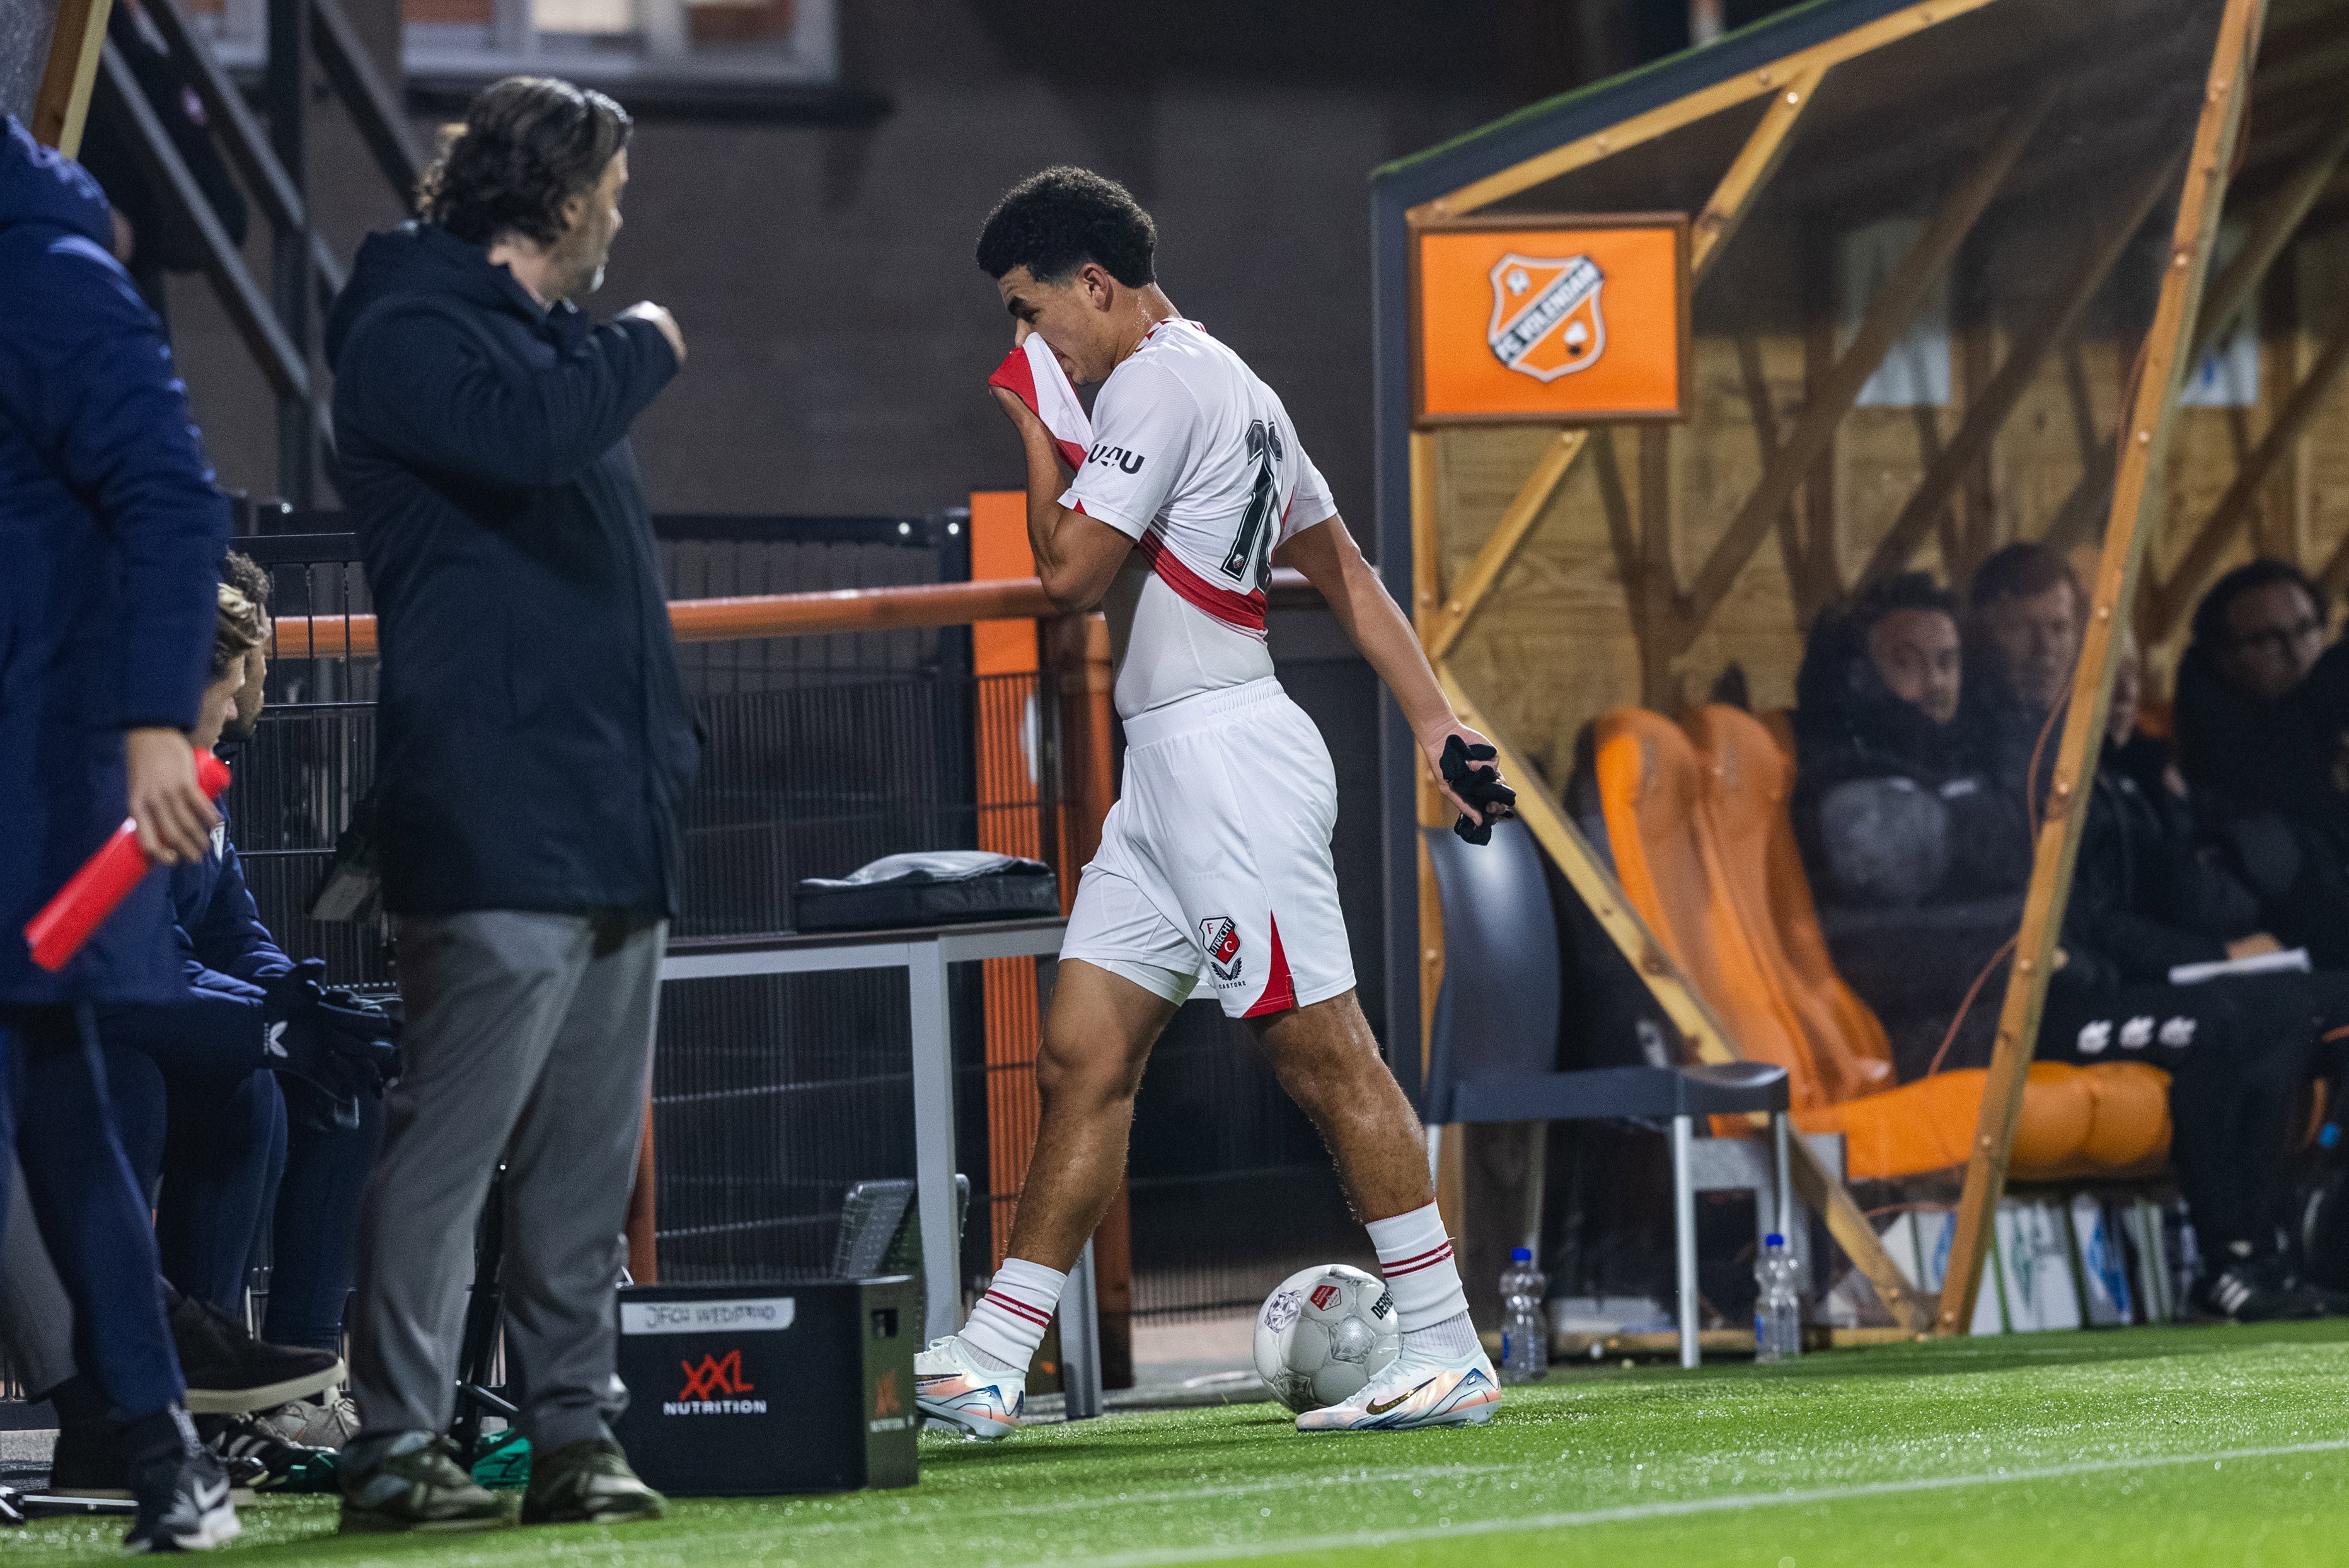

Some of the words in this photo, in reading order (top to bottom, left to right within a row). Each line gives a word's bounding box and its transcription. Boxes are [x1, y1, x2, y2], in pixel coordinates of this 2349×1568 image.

[1206, 923, 1214, 935] F
[1209, 919, 1233, 956] UTRECHT
[1224, 940, 1235, 953] C
[1218, 981, 1247, 989] CASTORE
[679, 1350, 754, 1402] XXL
[663, 1398, 767, 1416] NUTRITION
